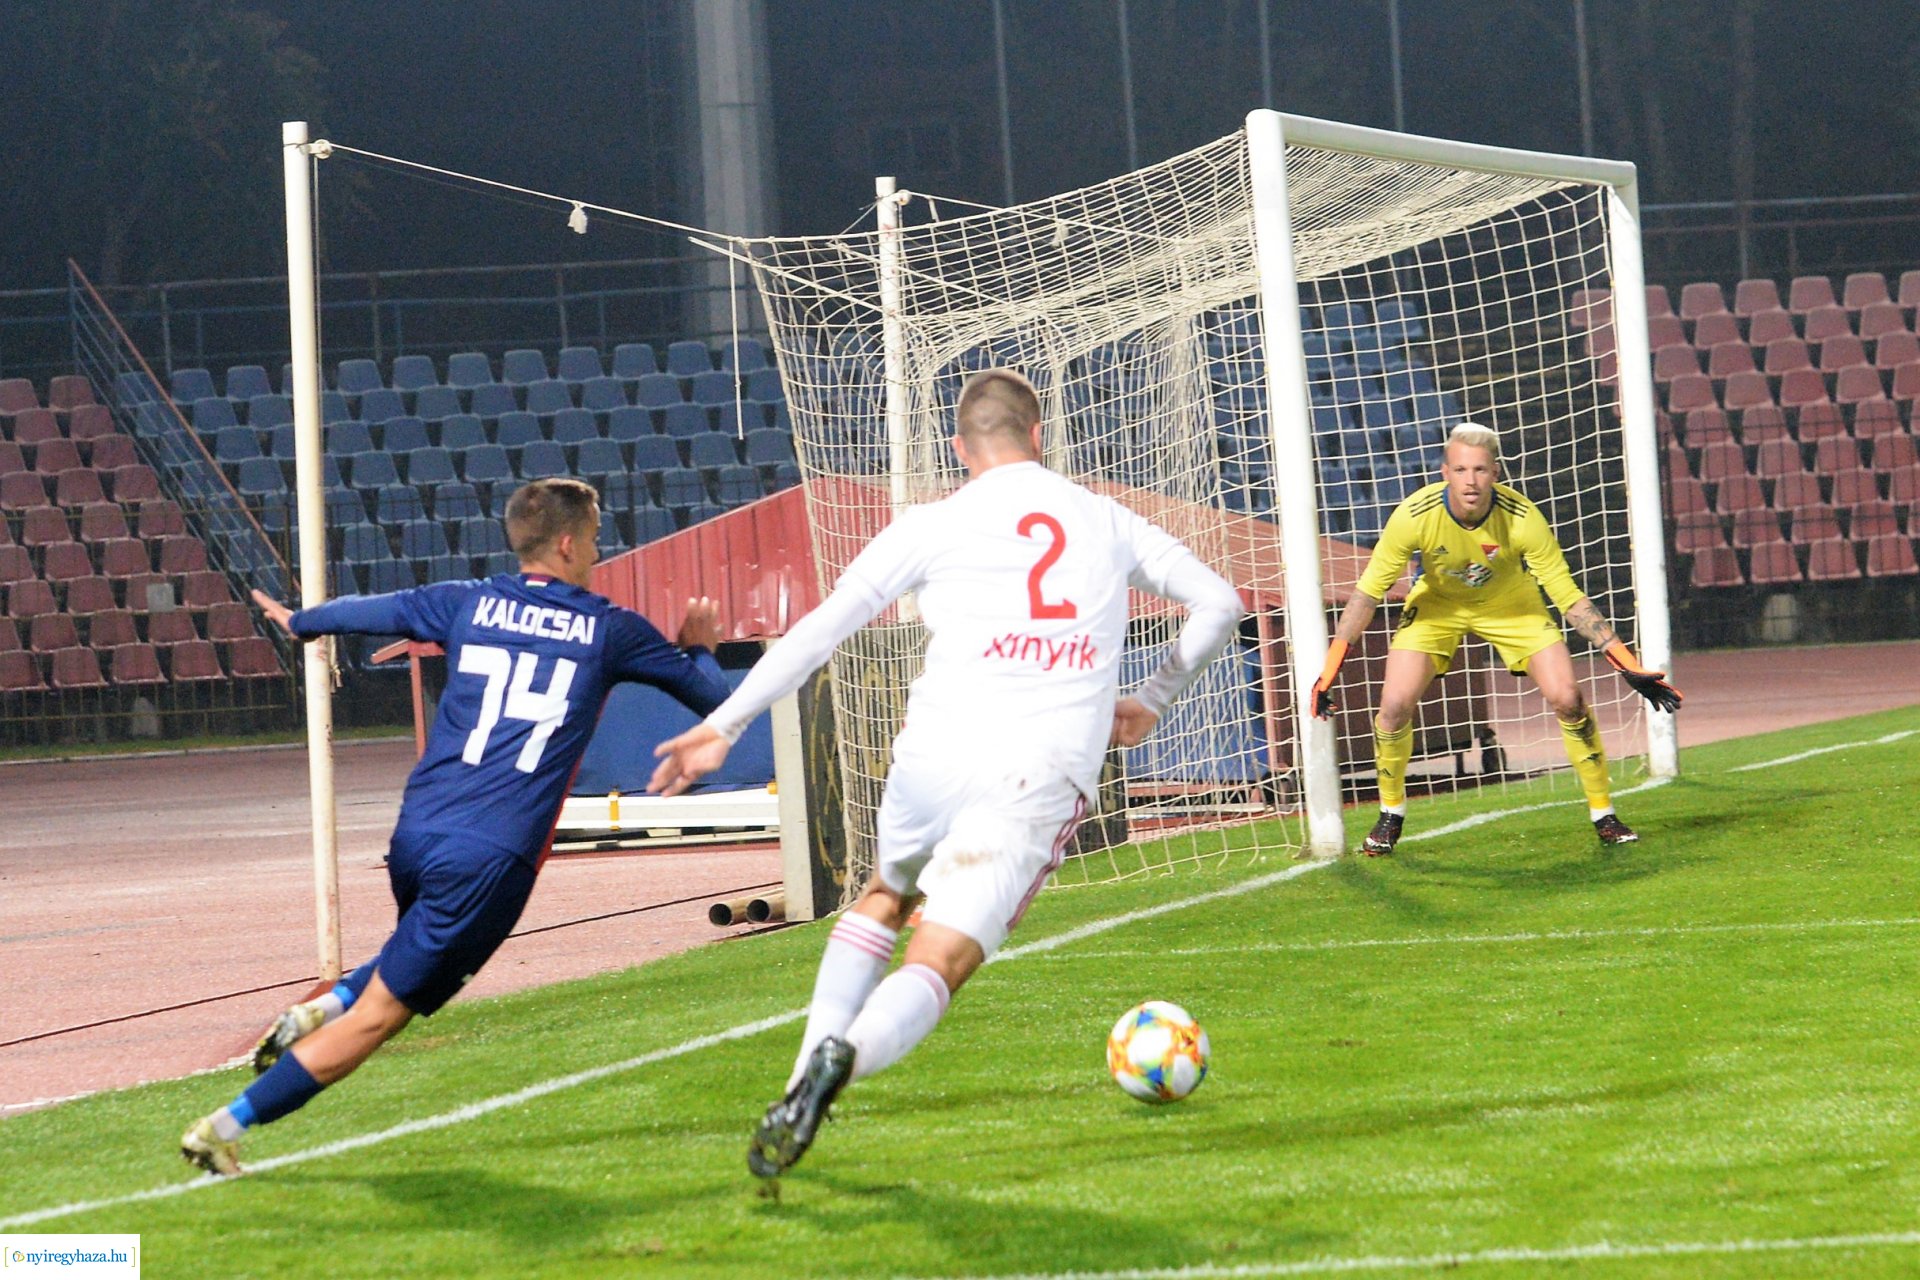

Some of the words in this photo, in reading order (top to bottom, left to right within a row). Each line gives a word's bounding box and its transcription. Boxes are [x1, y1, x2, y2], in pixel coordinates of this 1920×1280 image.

[1016, 512, 1077, 620] 2
[472, 596, 596, 645] KALOCSAI
[457, 644, 578, 774] 74
